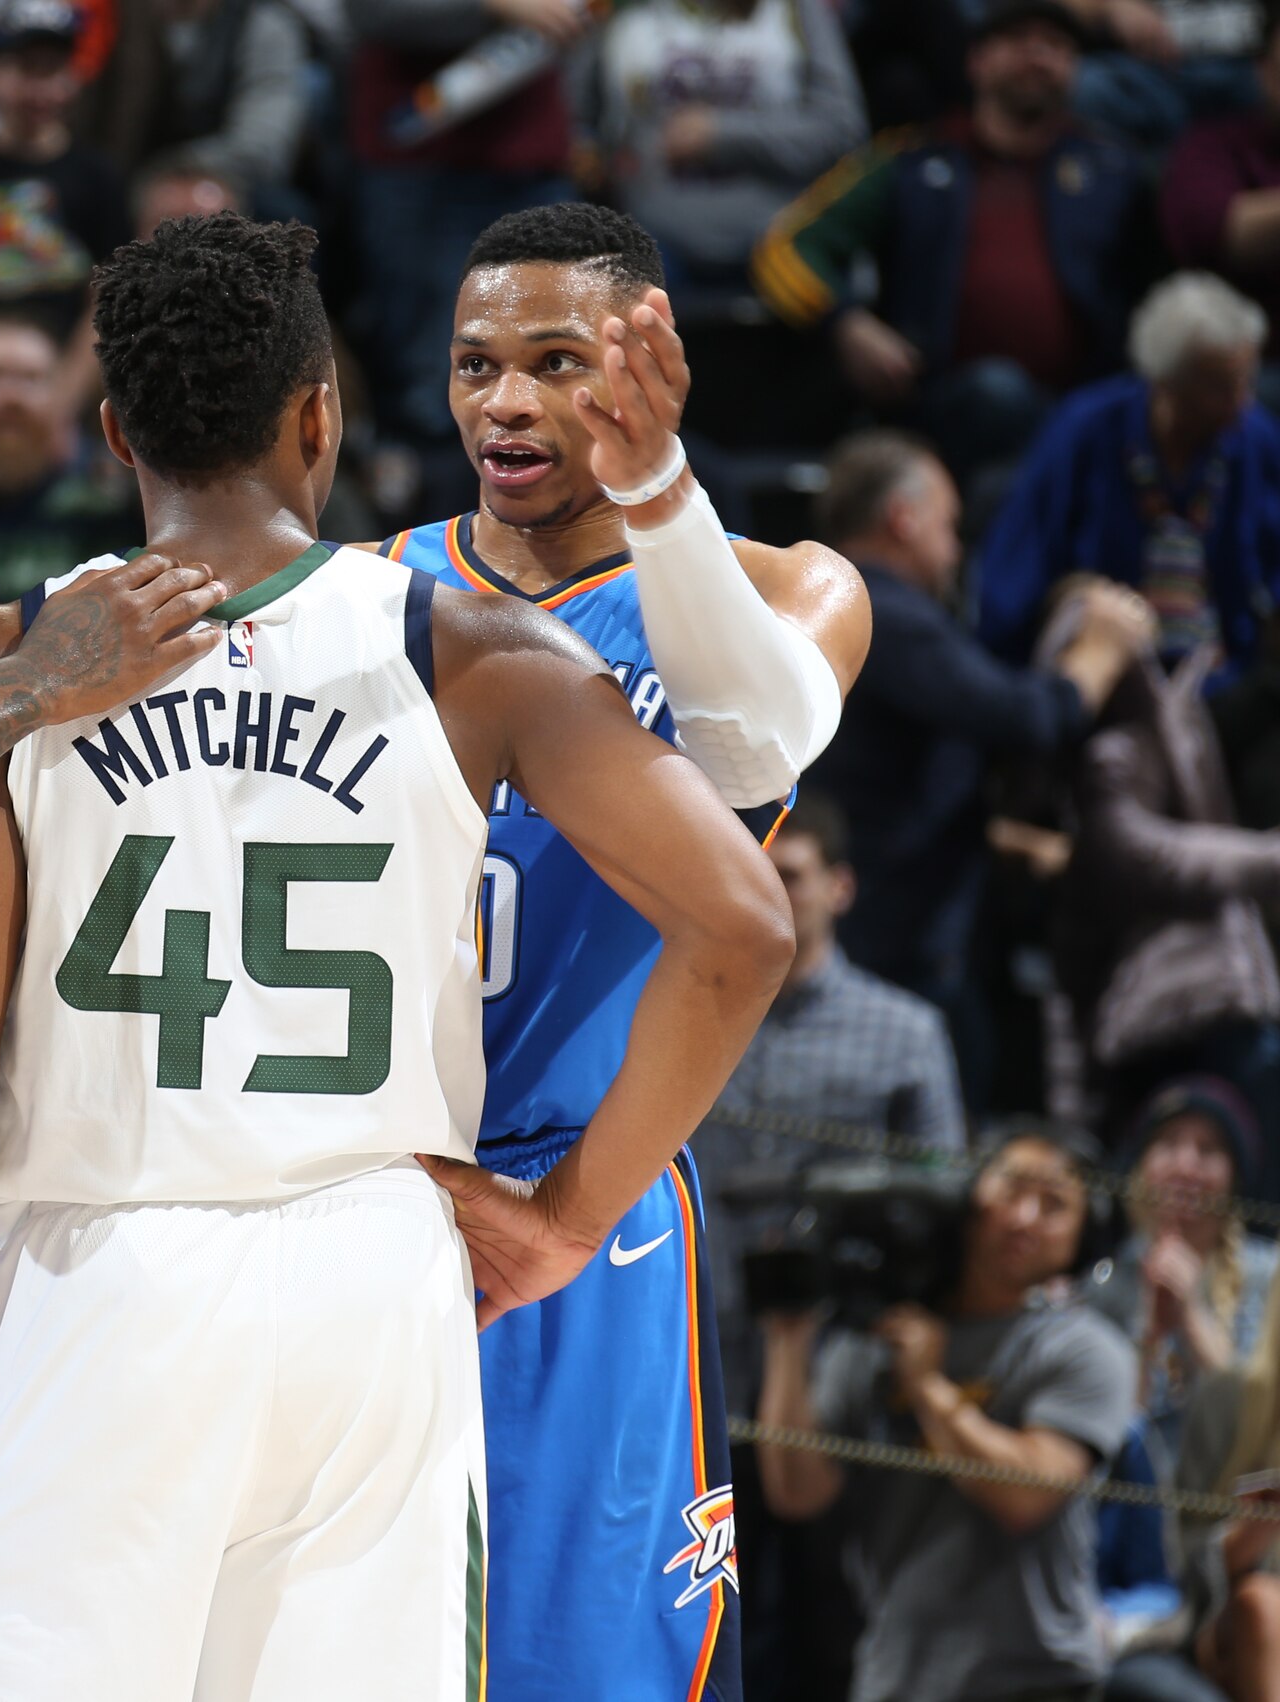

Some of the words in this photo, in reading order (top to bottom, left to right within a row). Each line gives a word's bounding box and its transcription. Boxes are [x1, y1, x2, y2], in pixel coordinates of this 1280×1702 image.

[231, 655, 247, 665] NBA
[71, 688, 389, 815] MITCHELL
[55, 834, 395, 1095] 45
